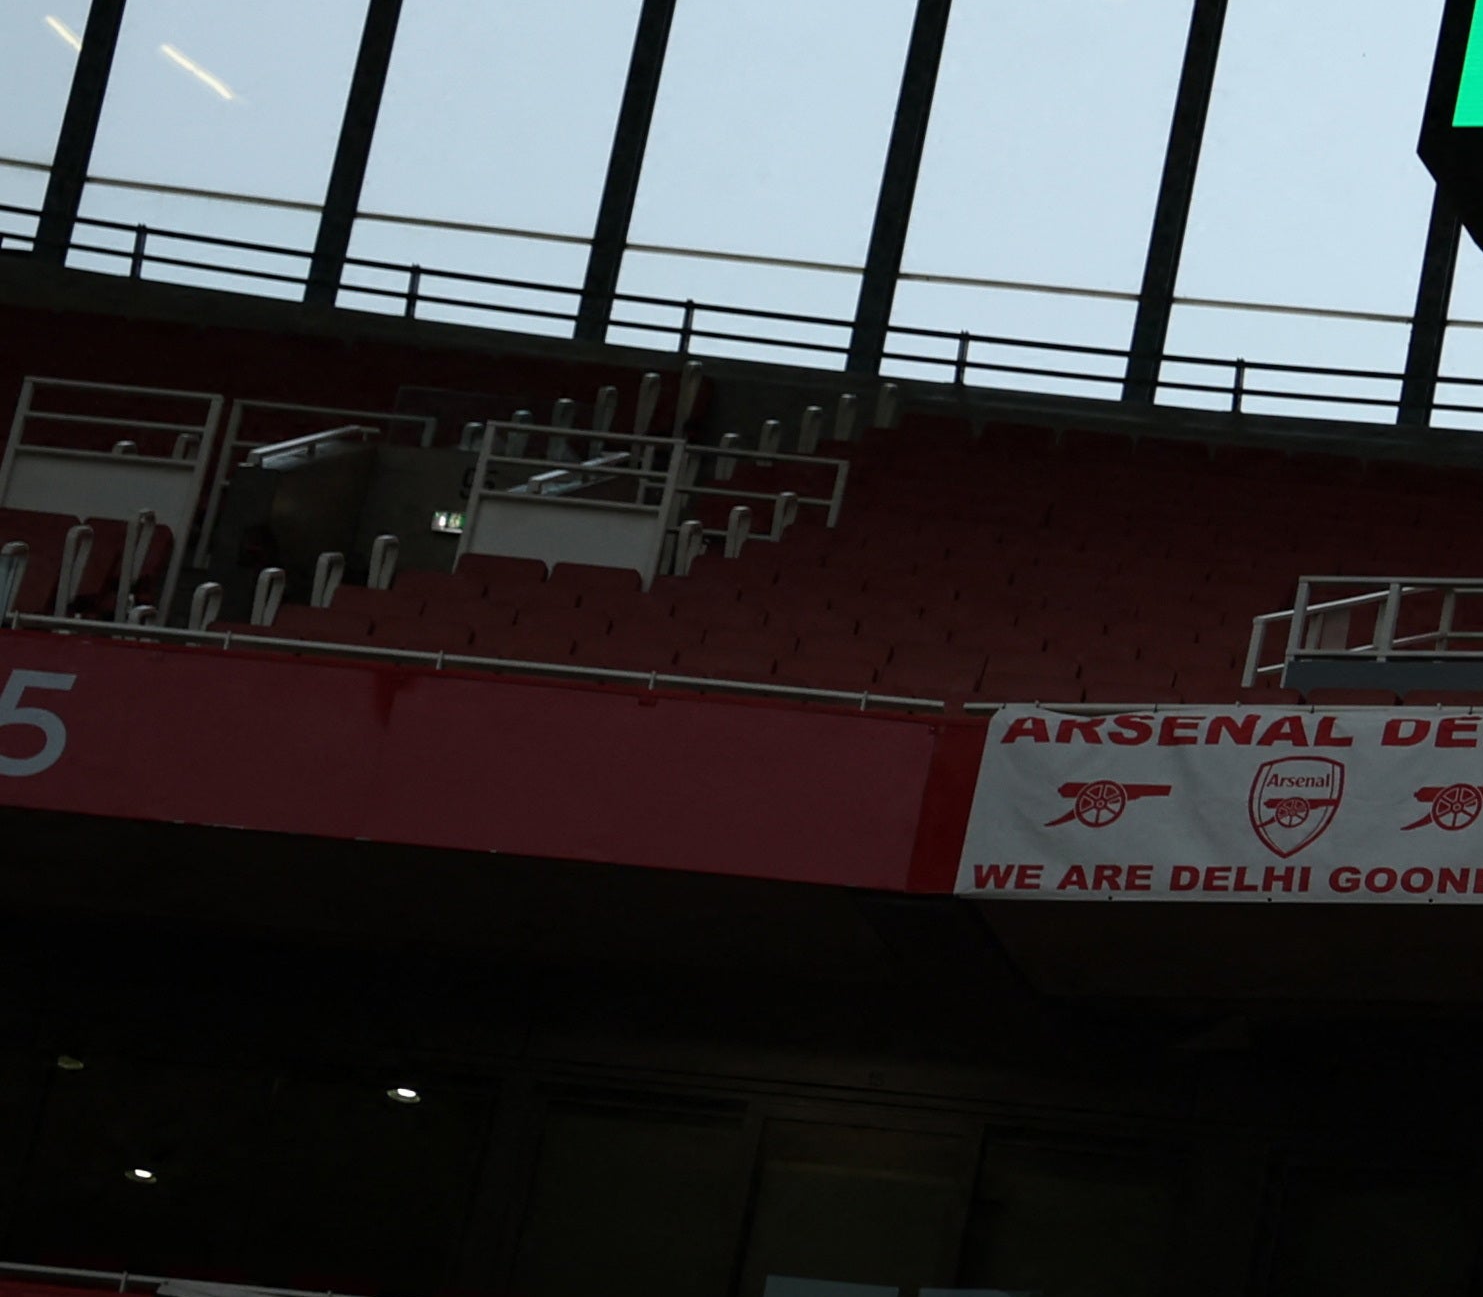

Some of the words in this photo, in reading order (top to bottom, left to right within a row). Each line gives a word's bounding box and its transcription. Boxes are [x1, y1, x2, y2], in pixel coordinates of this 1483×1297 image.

[1001, 714, 1353, 747] ARSENAL
[1266, 773, 1330, 789] Arsenal
[973, 863, 1044, 891] WE
[1056, 864, 1154, 891] ARE
[1170, 866, 1310, 892] DELHI
